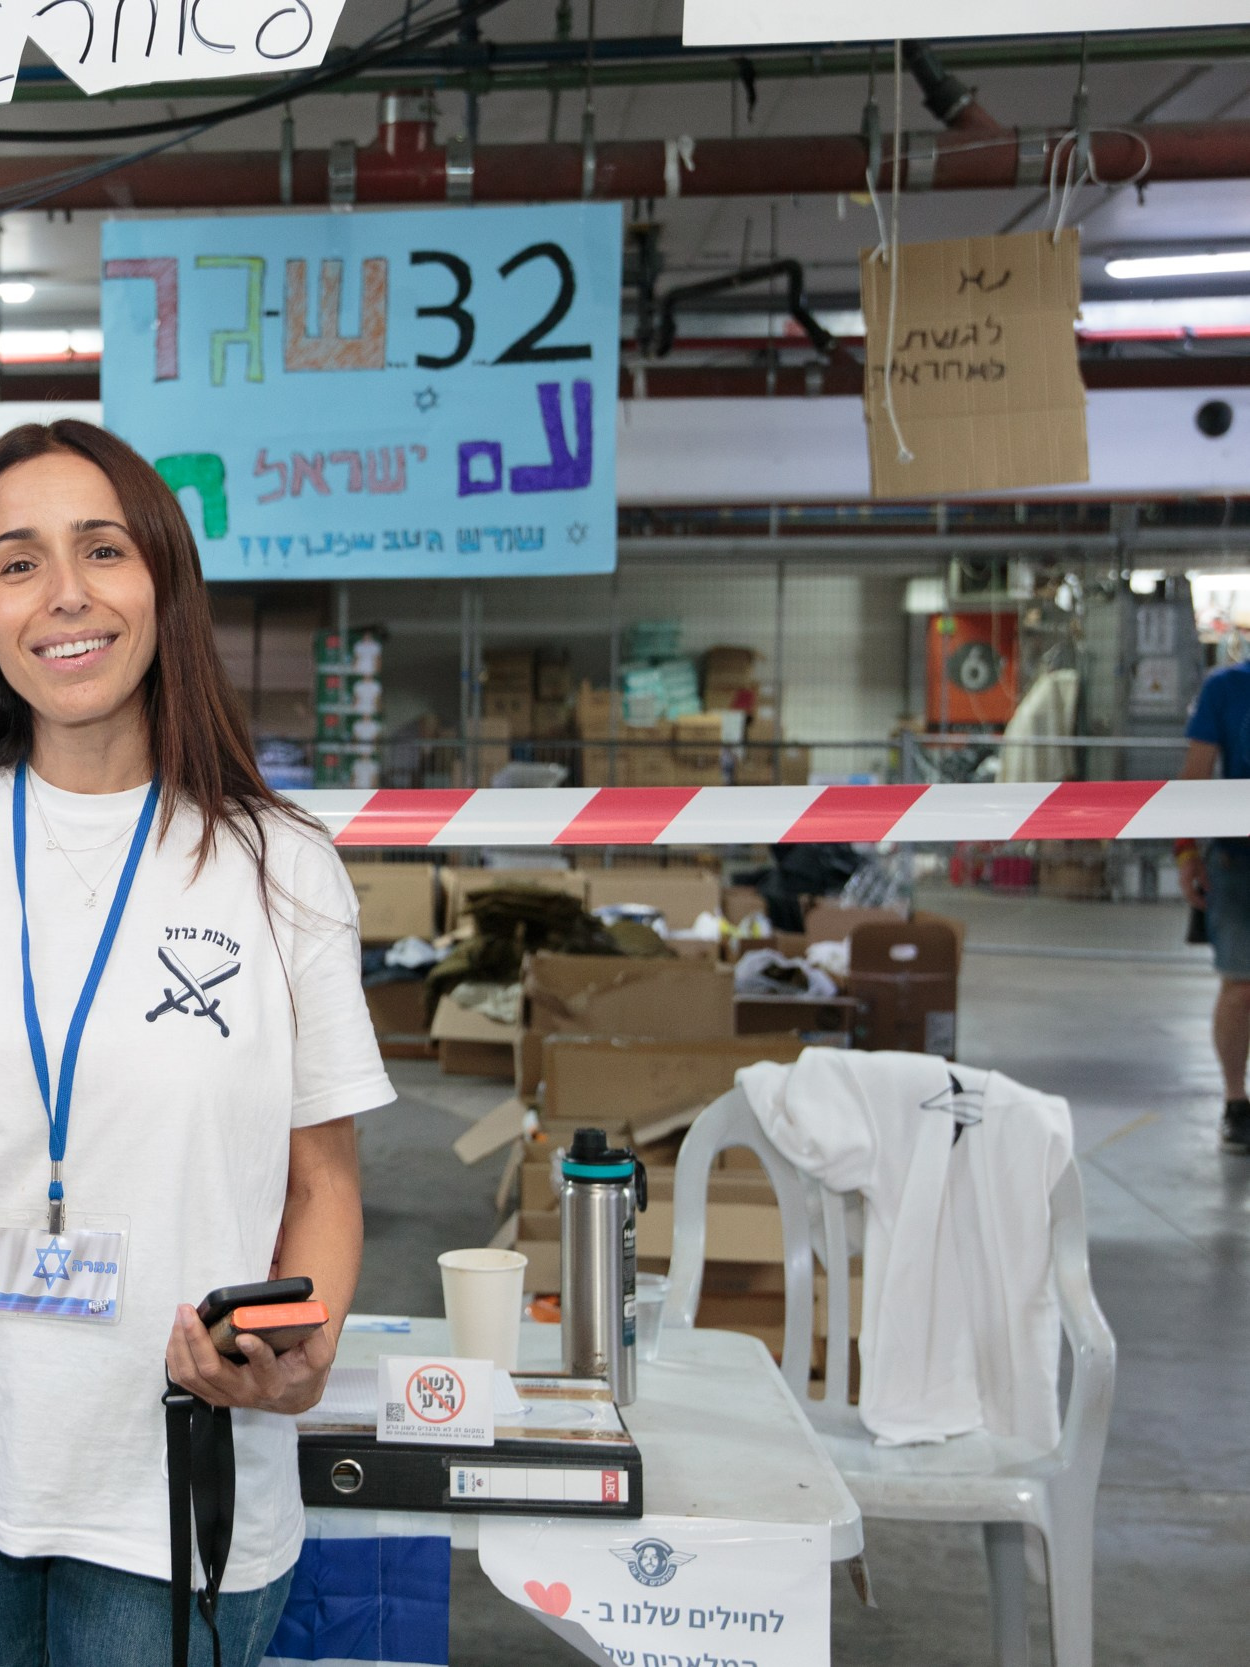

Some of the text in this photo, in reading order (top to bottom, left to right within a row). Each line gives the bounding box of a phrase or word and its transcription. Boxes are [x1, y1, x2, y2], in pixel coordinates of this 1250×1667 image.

[898, 314, 1003, 353] לגשת
[458, 379, 593, 497] עם
[253, 443, 427, 504] ישראל
[165, 926, 241, 956] חרבות ברזל
[71, 1260, 117, 1274] תמרה
[604, 1474, 617, 1499] ABC
[622, 1600, 681, 1627] שלנו
[688, 1605, 785, 1634] לחיילים
